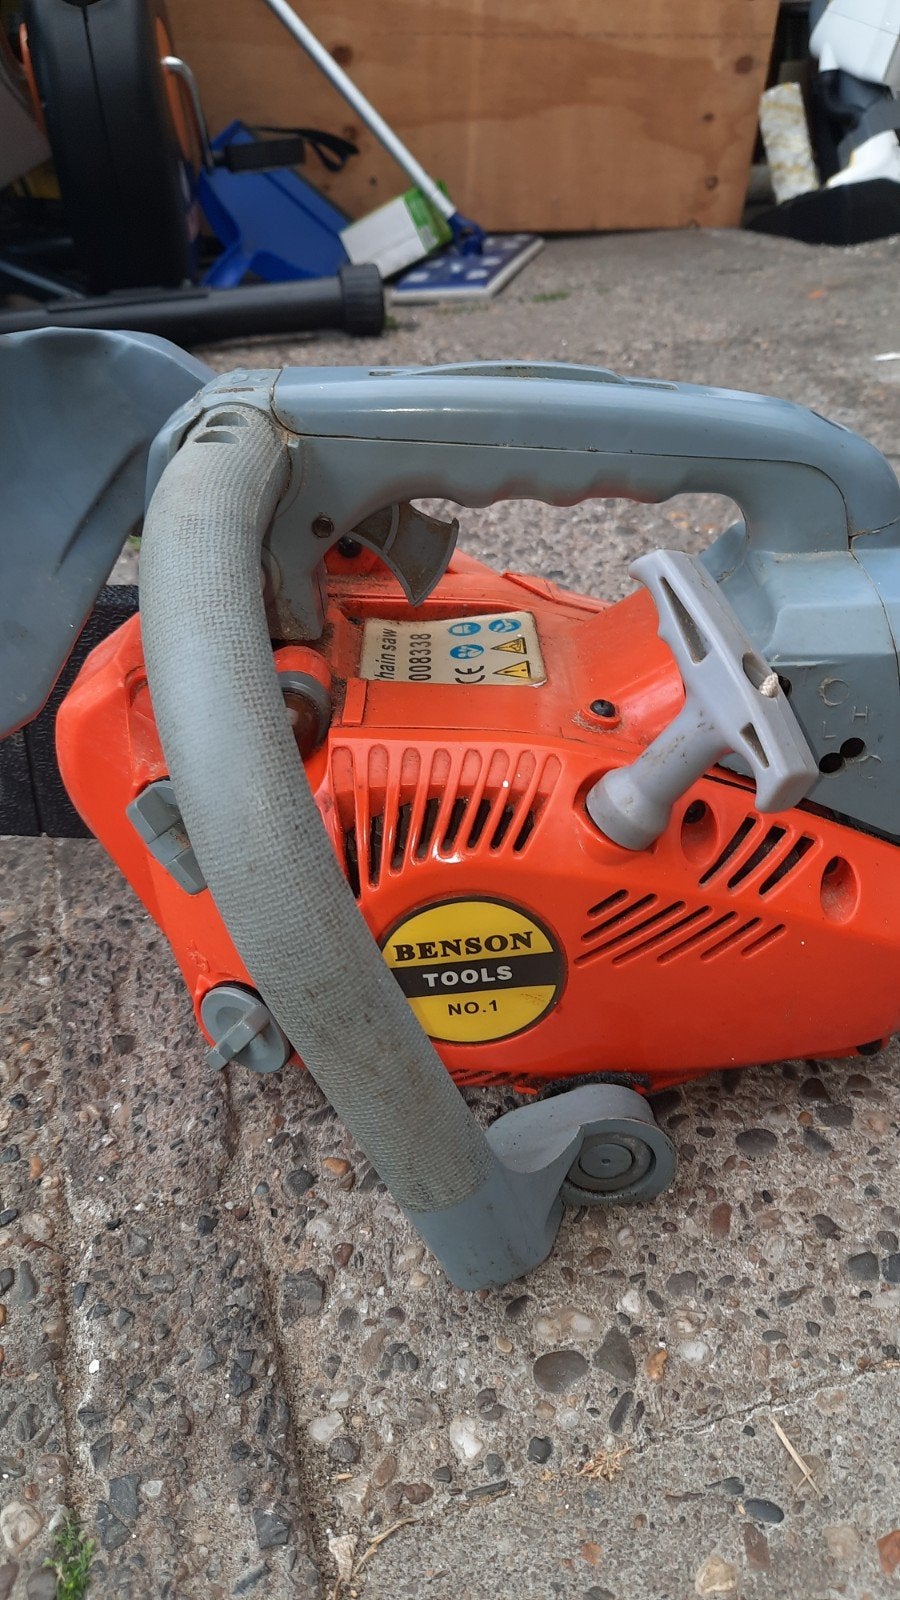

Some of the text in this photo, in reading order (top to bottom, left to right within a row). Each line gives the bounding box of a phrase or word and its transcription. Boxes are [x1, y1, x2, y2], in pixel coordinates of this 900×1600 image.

[374, 628, 398, 681] hain saw
[408, 633, 432, 681] 008338
[455, 665, 486, 684] CE
[393, 931, 533, 962] BENSON
[422, 965, 513, 988] TOOLS
[447, 1000, 498, 1016] NO.1
